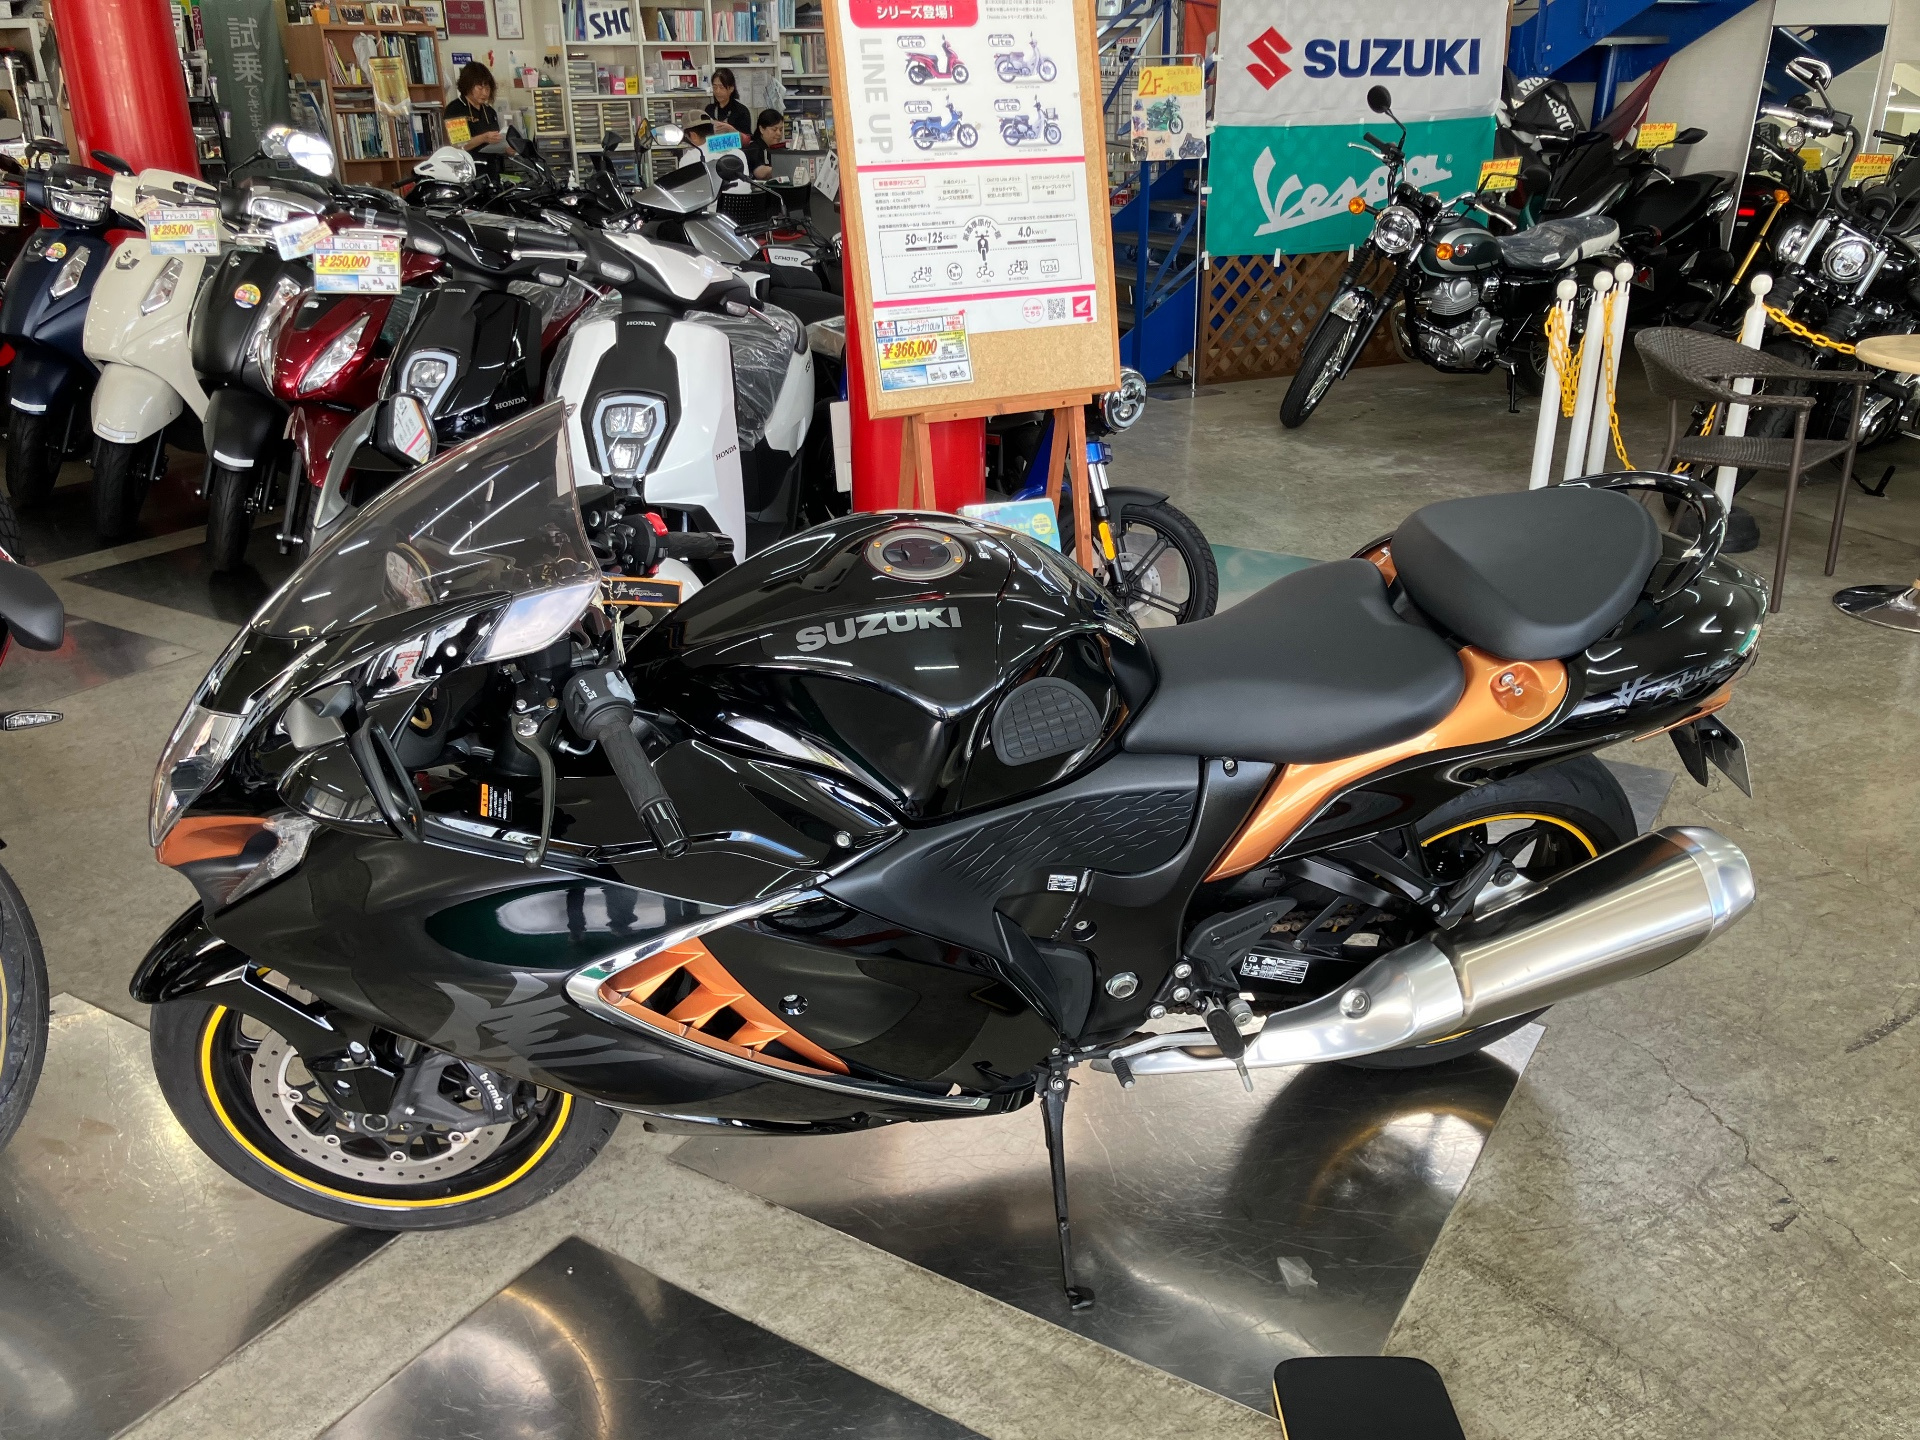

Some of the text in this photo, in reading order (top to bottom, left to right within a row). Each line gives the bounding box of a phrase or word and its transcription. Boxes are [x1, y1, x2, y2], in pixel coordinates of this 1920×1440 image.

[991, 38, 1012, 46] Lite
[1303, 38, 1481, 78] SUZUKI
[1139, 70, 1164, 96] 2F
[860, 39, 893, 154] LINE UP
[997, 102, 1018, 111] Lite
[907, 104, 929, 113] Lite
[1252, 147, 1452, 237] Vespa
[319, 254, 371, 268] ¥250,000
[882, 338, 938, 360] ¥366,000
[494, 396, 528, 410] HONDA
[715, 444, 738, 461] HONDA
[795, 606, 962, 652] SUZUKI
[480, 1072, 504, 1110] brembo
